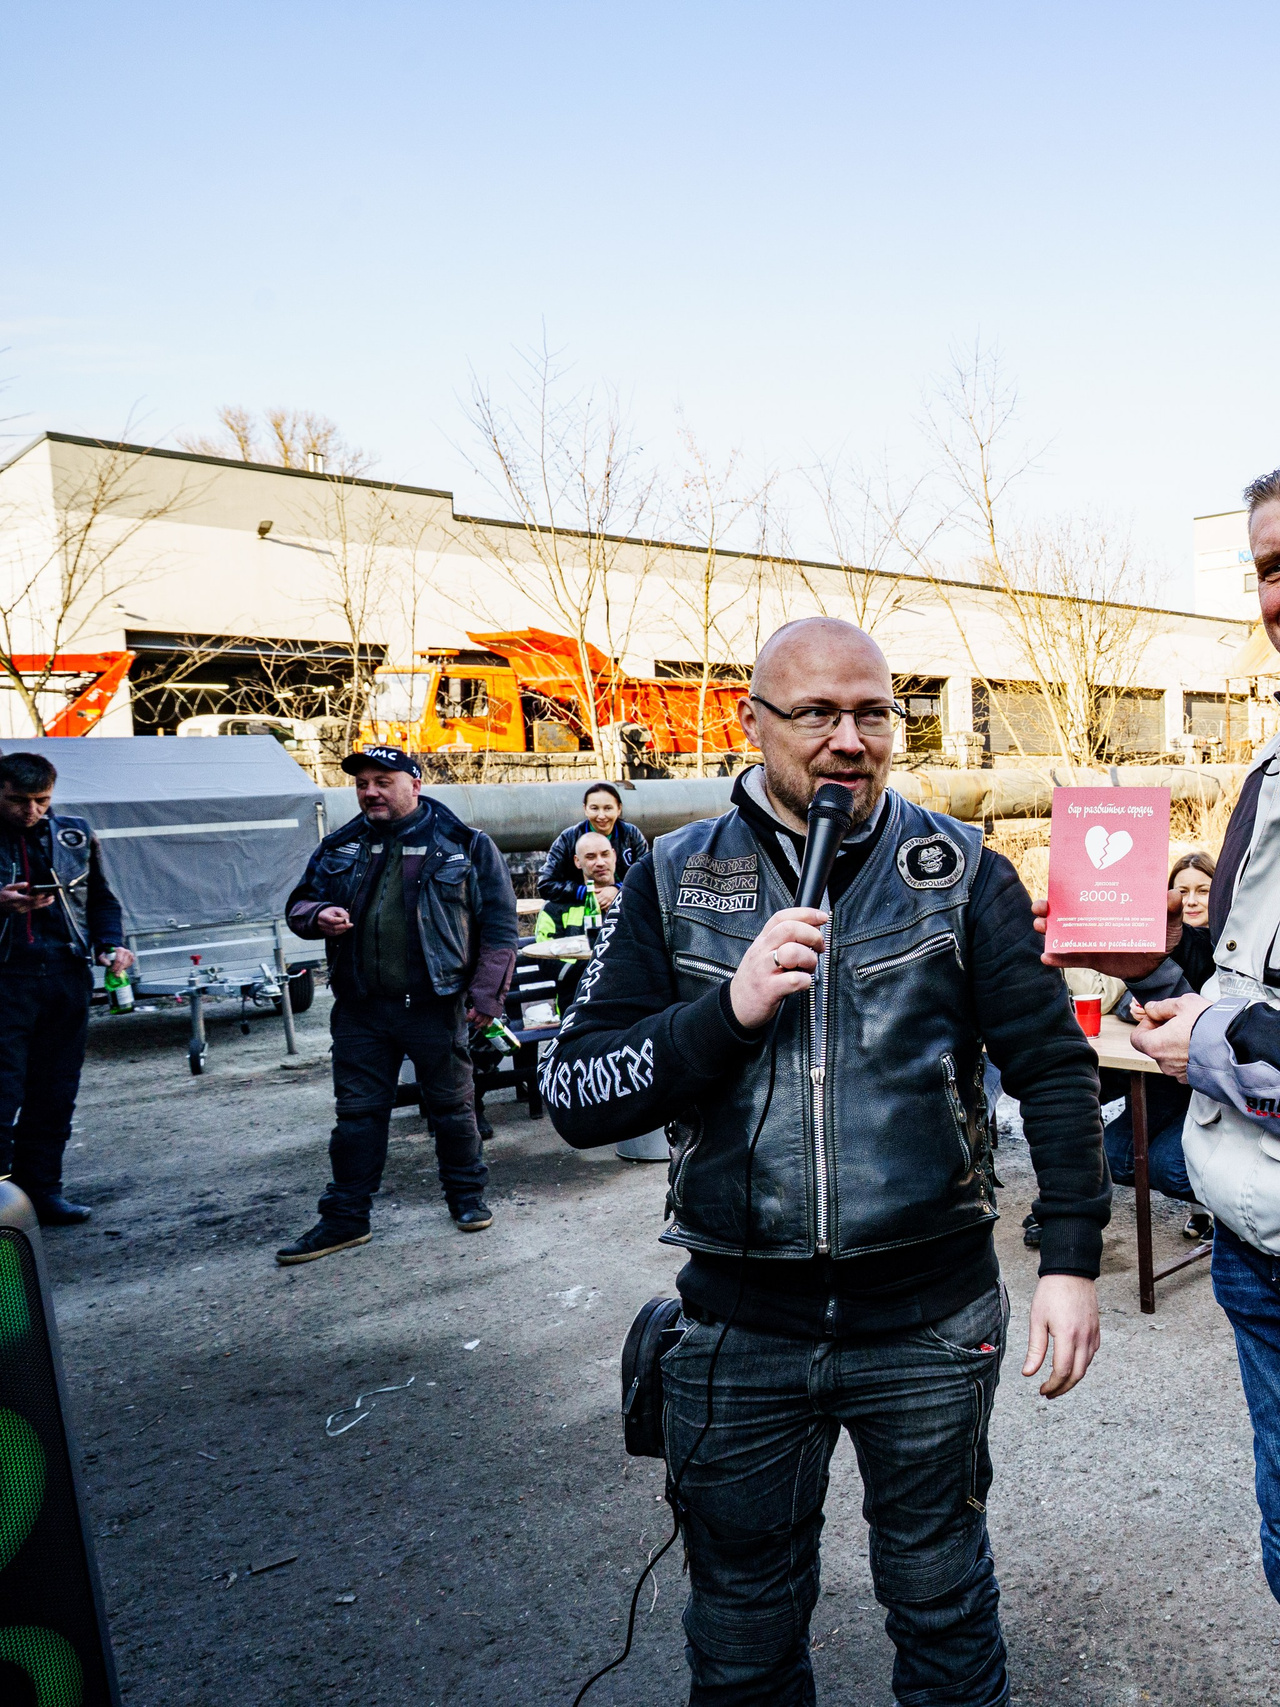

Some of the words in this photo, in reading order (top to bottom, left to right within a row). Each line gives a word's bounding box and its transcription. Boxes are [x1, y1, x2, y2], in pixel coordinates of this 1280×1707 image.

[1068, 802, 1082, 818] бар
[1083, 802, 1126, 818] разбитых
[1127, 805, 1154, 818] сердец
[683, 890, 753, 910] PRESIDENT
[1079, 890, 1117, 902] 2000
[1060, 939, 1097, 948] любимыми
[1108, 938, 1157, 950] расставайтесь
